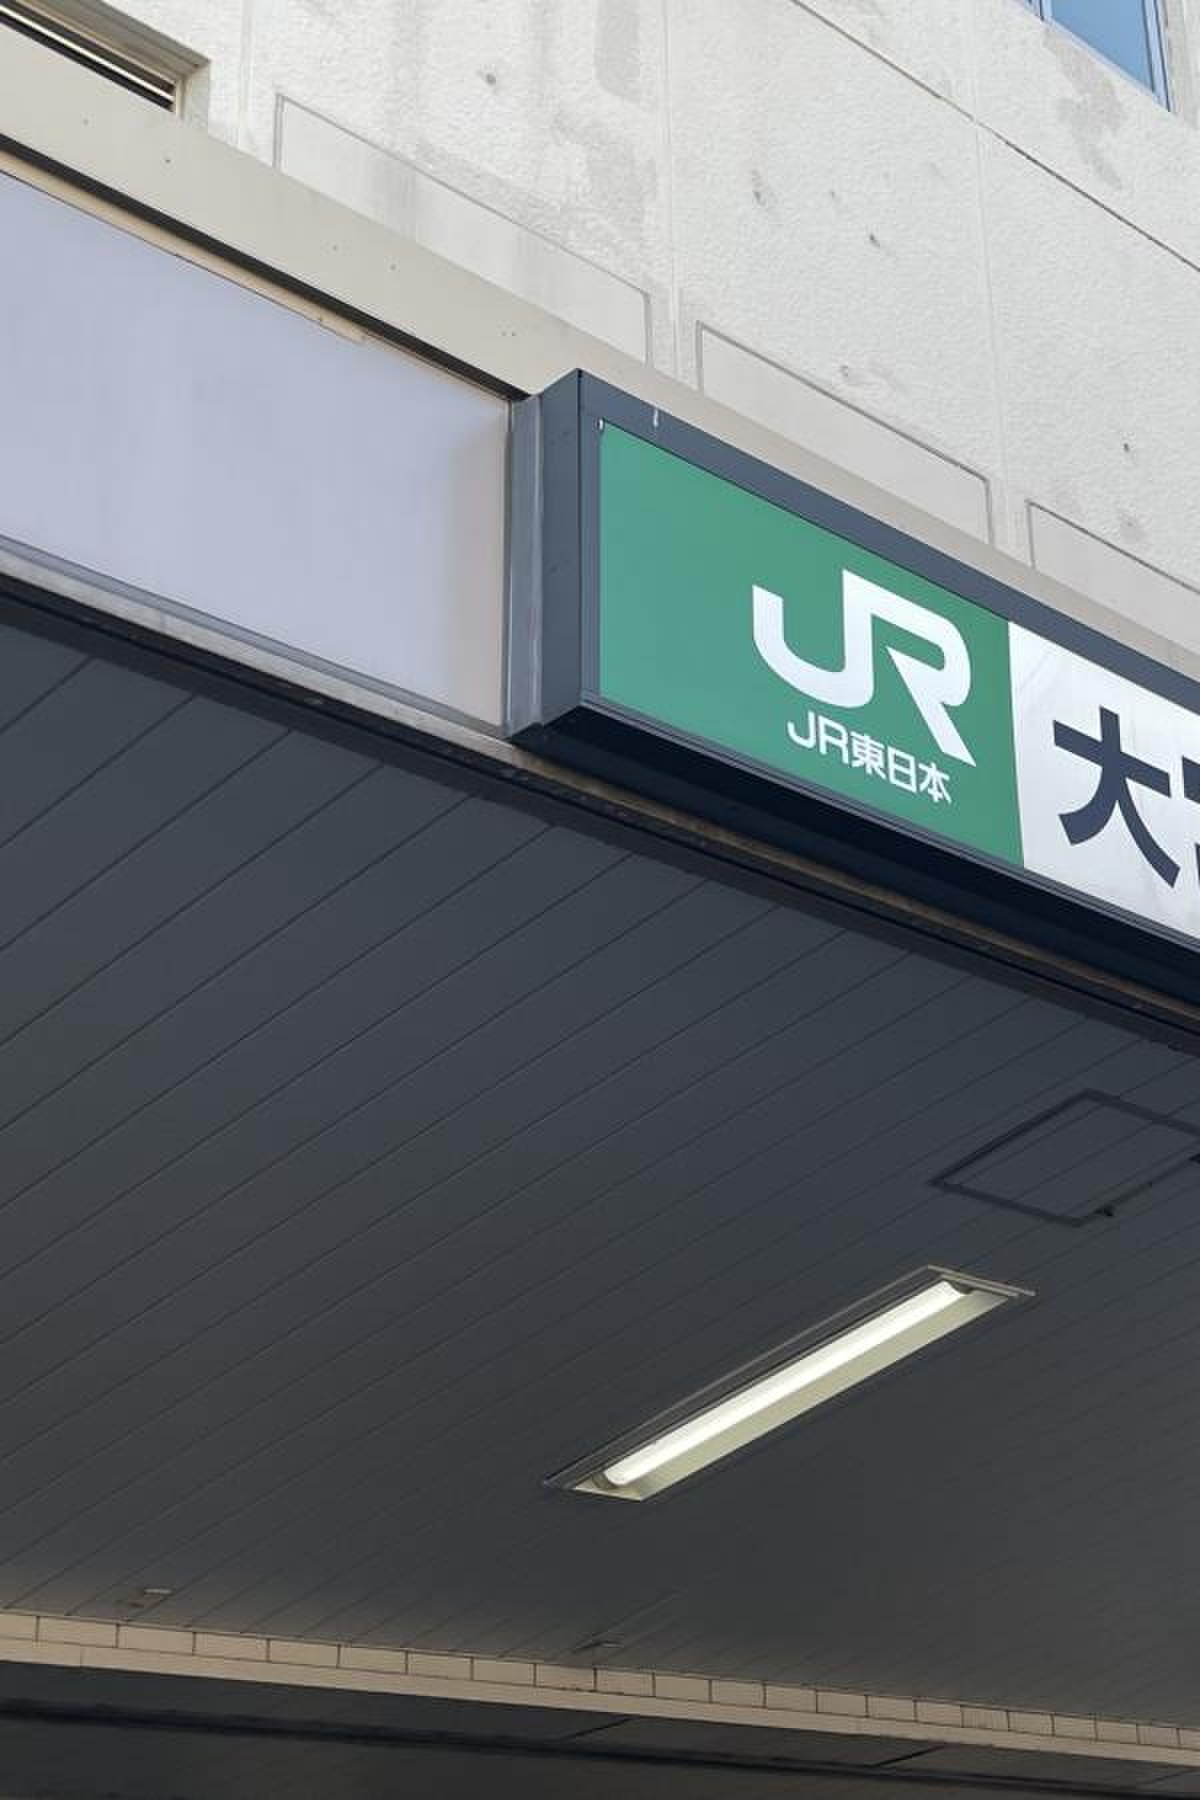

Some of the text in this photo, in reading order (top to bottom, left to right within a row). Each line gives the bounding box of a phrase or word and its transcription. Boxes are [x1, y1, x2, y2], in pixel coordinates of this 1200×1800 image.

[752, 569, 977, 767] JR
[787, 711, 952, 803] JR東日本
